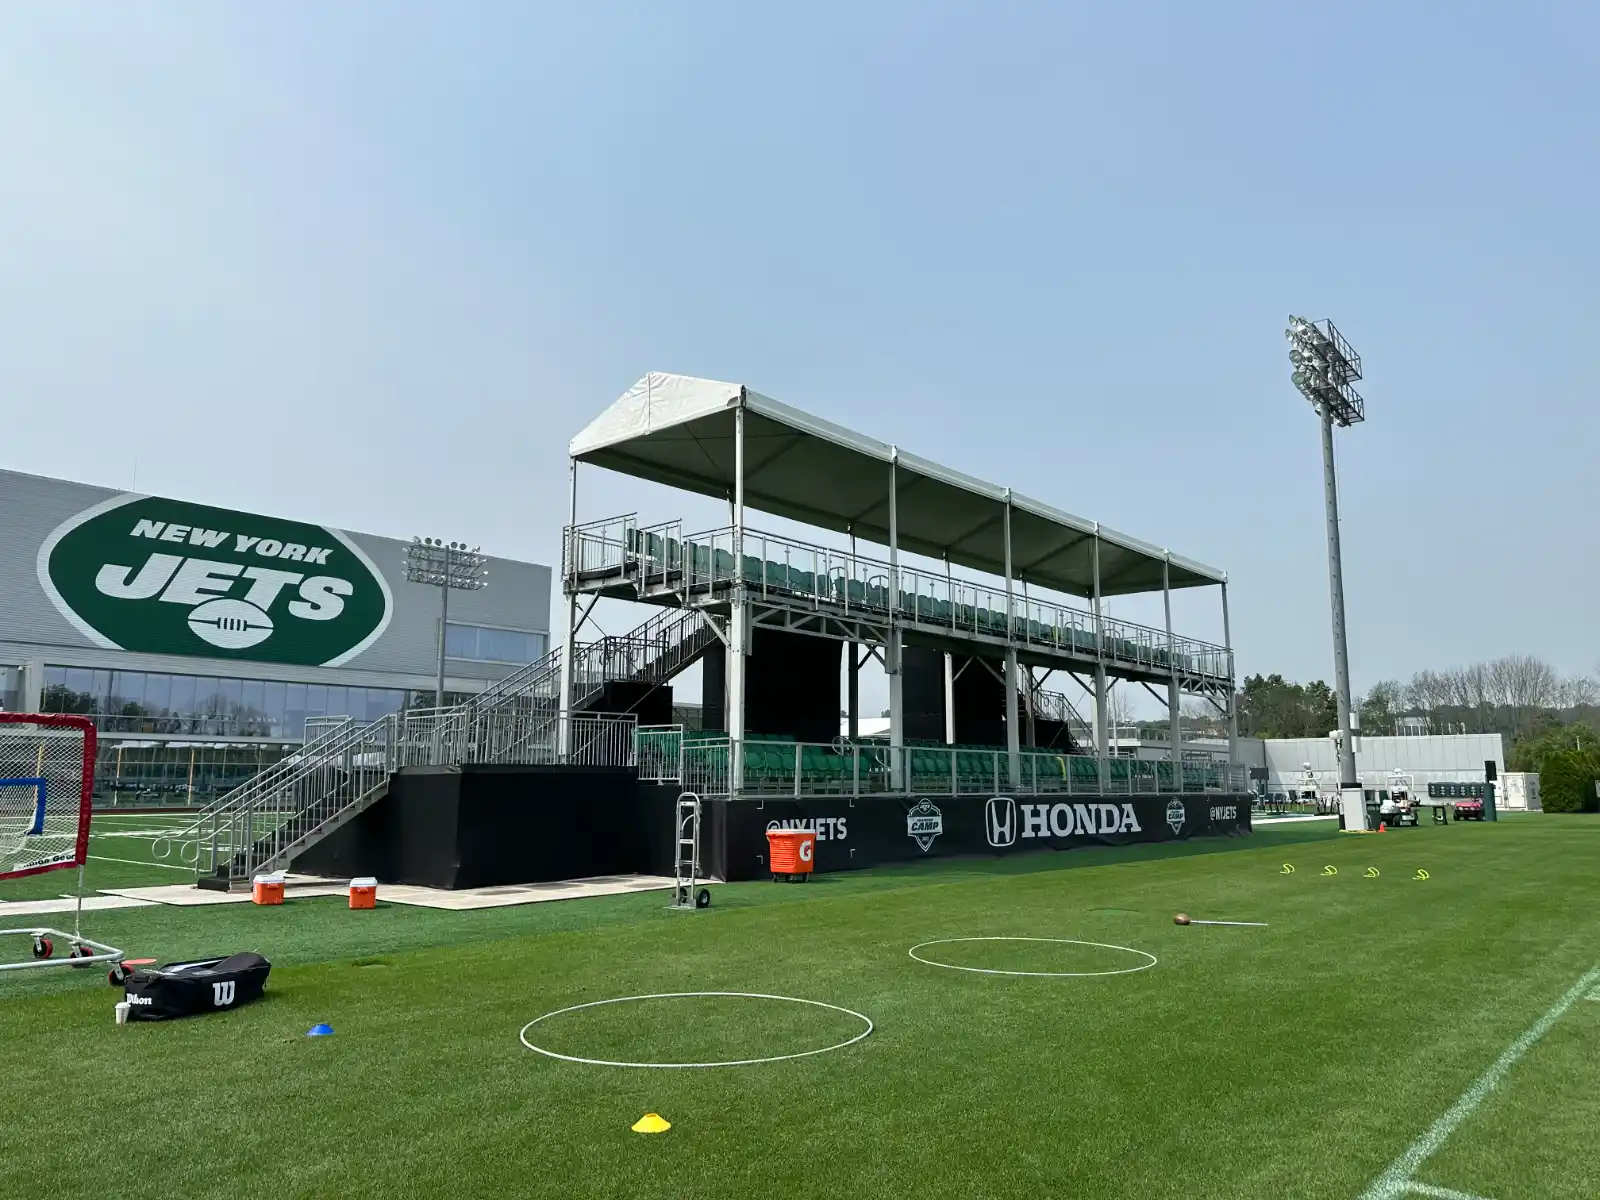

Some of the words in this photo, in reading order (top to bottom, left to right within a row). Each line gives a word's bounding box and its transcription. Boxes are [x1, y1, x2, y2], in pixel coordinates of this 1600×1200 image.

[129, 518, 230, 548] NEW
[234, 534, 334, 565] YORK
[95, 552, 353, 621] JETS
[911, 821, 939, 831] CAMP
[1020, 803, 1142, 838] HONDA
[1209, 806, 1237, 820] @NYJETS
[799, 840, 811, 862] G
